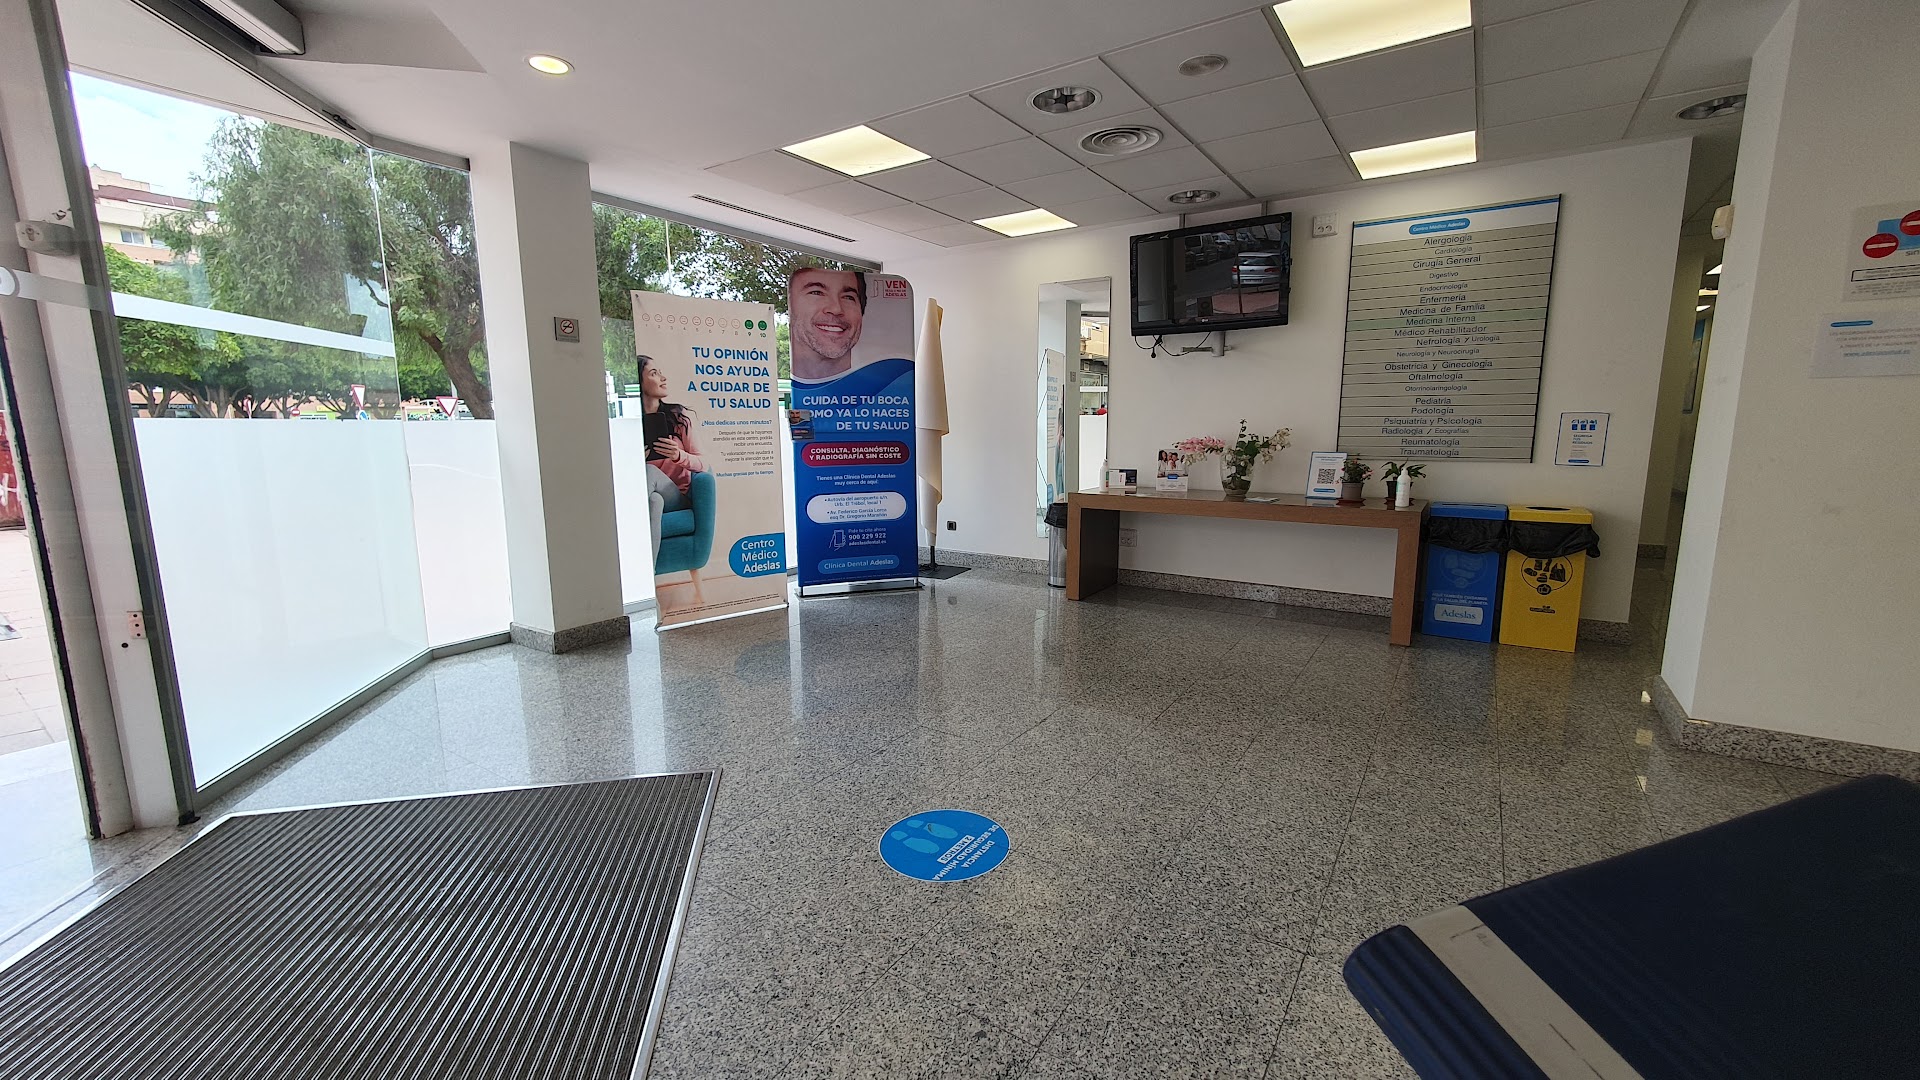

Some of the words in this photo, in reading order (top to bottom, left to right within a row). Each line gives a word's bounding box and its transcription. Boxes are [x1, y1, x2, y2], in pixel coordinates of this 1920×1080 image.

[1424, 234, 1473, 246] Alergología
[1434, 246, 1473, 255] Cardiología
[1412, 259, 1444, 269] Cirugía
[1446, 255, 1481, 265] General
[1429, 271, 1459, 279] Digestivo
[885, 280, 906, 289] VEN
[1420, 283, 1468, 292] Endocrinología
[1420, 294, 1466, 304] Enfermería
[1400, 307, 1436, 316] Medicina
[1455, 303, 1486, 312] Familia
[1406, 317, 1443, 326] Medicina
[1394, 329, 1425, 337] Médico
[1428, 326, 1487, 335] Rehabilitador
[1416, 337, 1461, 346] Nefrología
[692, 347, 710, 358] TU
[714, 348, 768, 361] OPINIÓN
[1397, 349, 1430, 357] Neurología
[1438, 348, 1479, 356] Neurocirugía
[695, 364, 723, 375] NOS
[727, 366, 769, 377] AYUDA
[1384, 363, 1428, 371] Obstetricia
[1442, 360, 1493, 369] Ginecología
[1408, 372, 1463, 381] Oftalmología
[688, 381, 697, 391] A
[701, 381, 750, 392] CUIDAR
[754, 383, 770, 392] DE
[709, 398, 726, 408] TU
[730, 398, 771, 408] SALUD
[803, 396, 839, 406] CUIDA
[842, 395, 857, 405] DE
[860, 396, 875, 404] TU
[878, 396, 909, 405] BOCA
[1415, 397, 1451, 405] Pediatría
[810, 409, 834, 418] OMO
[836, 409, 852, 418] YA
[855, 409, 869, 417] LO
[869, 409, 910, 417] HACES
[1411, 407, 1454, 415] Podología
[836, 422, 852, 430] DE
[855, 422, 870, 430] TU
[873, 421, 910, 430] SALUD
[1437, 417, 1482, 425] Psicología
[1401, 438, 1460, 447] Reumatología
[1400, 448, 1459, 457] Traumatología
[741, 539, 775, 550] Centro
[741, 550, 778, 562] Médico
[743, 561, 781, 574] Adeslas
[824, 562, 846, 570] Clínica
[847, 560, 869, 568] Dental
[1441, 609, 1476, 620] Adeslas
[988, 824, 1000, 833] DE
[940, 839, 968, 862] METROS
[956, 831, 992, 861] SEGURIDAD
[961, 840, 995, 868] DISTANCIA
[932, 860, 960, 880] MÍNIMA
